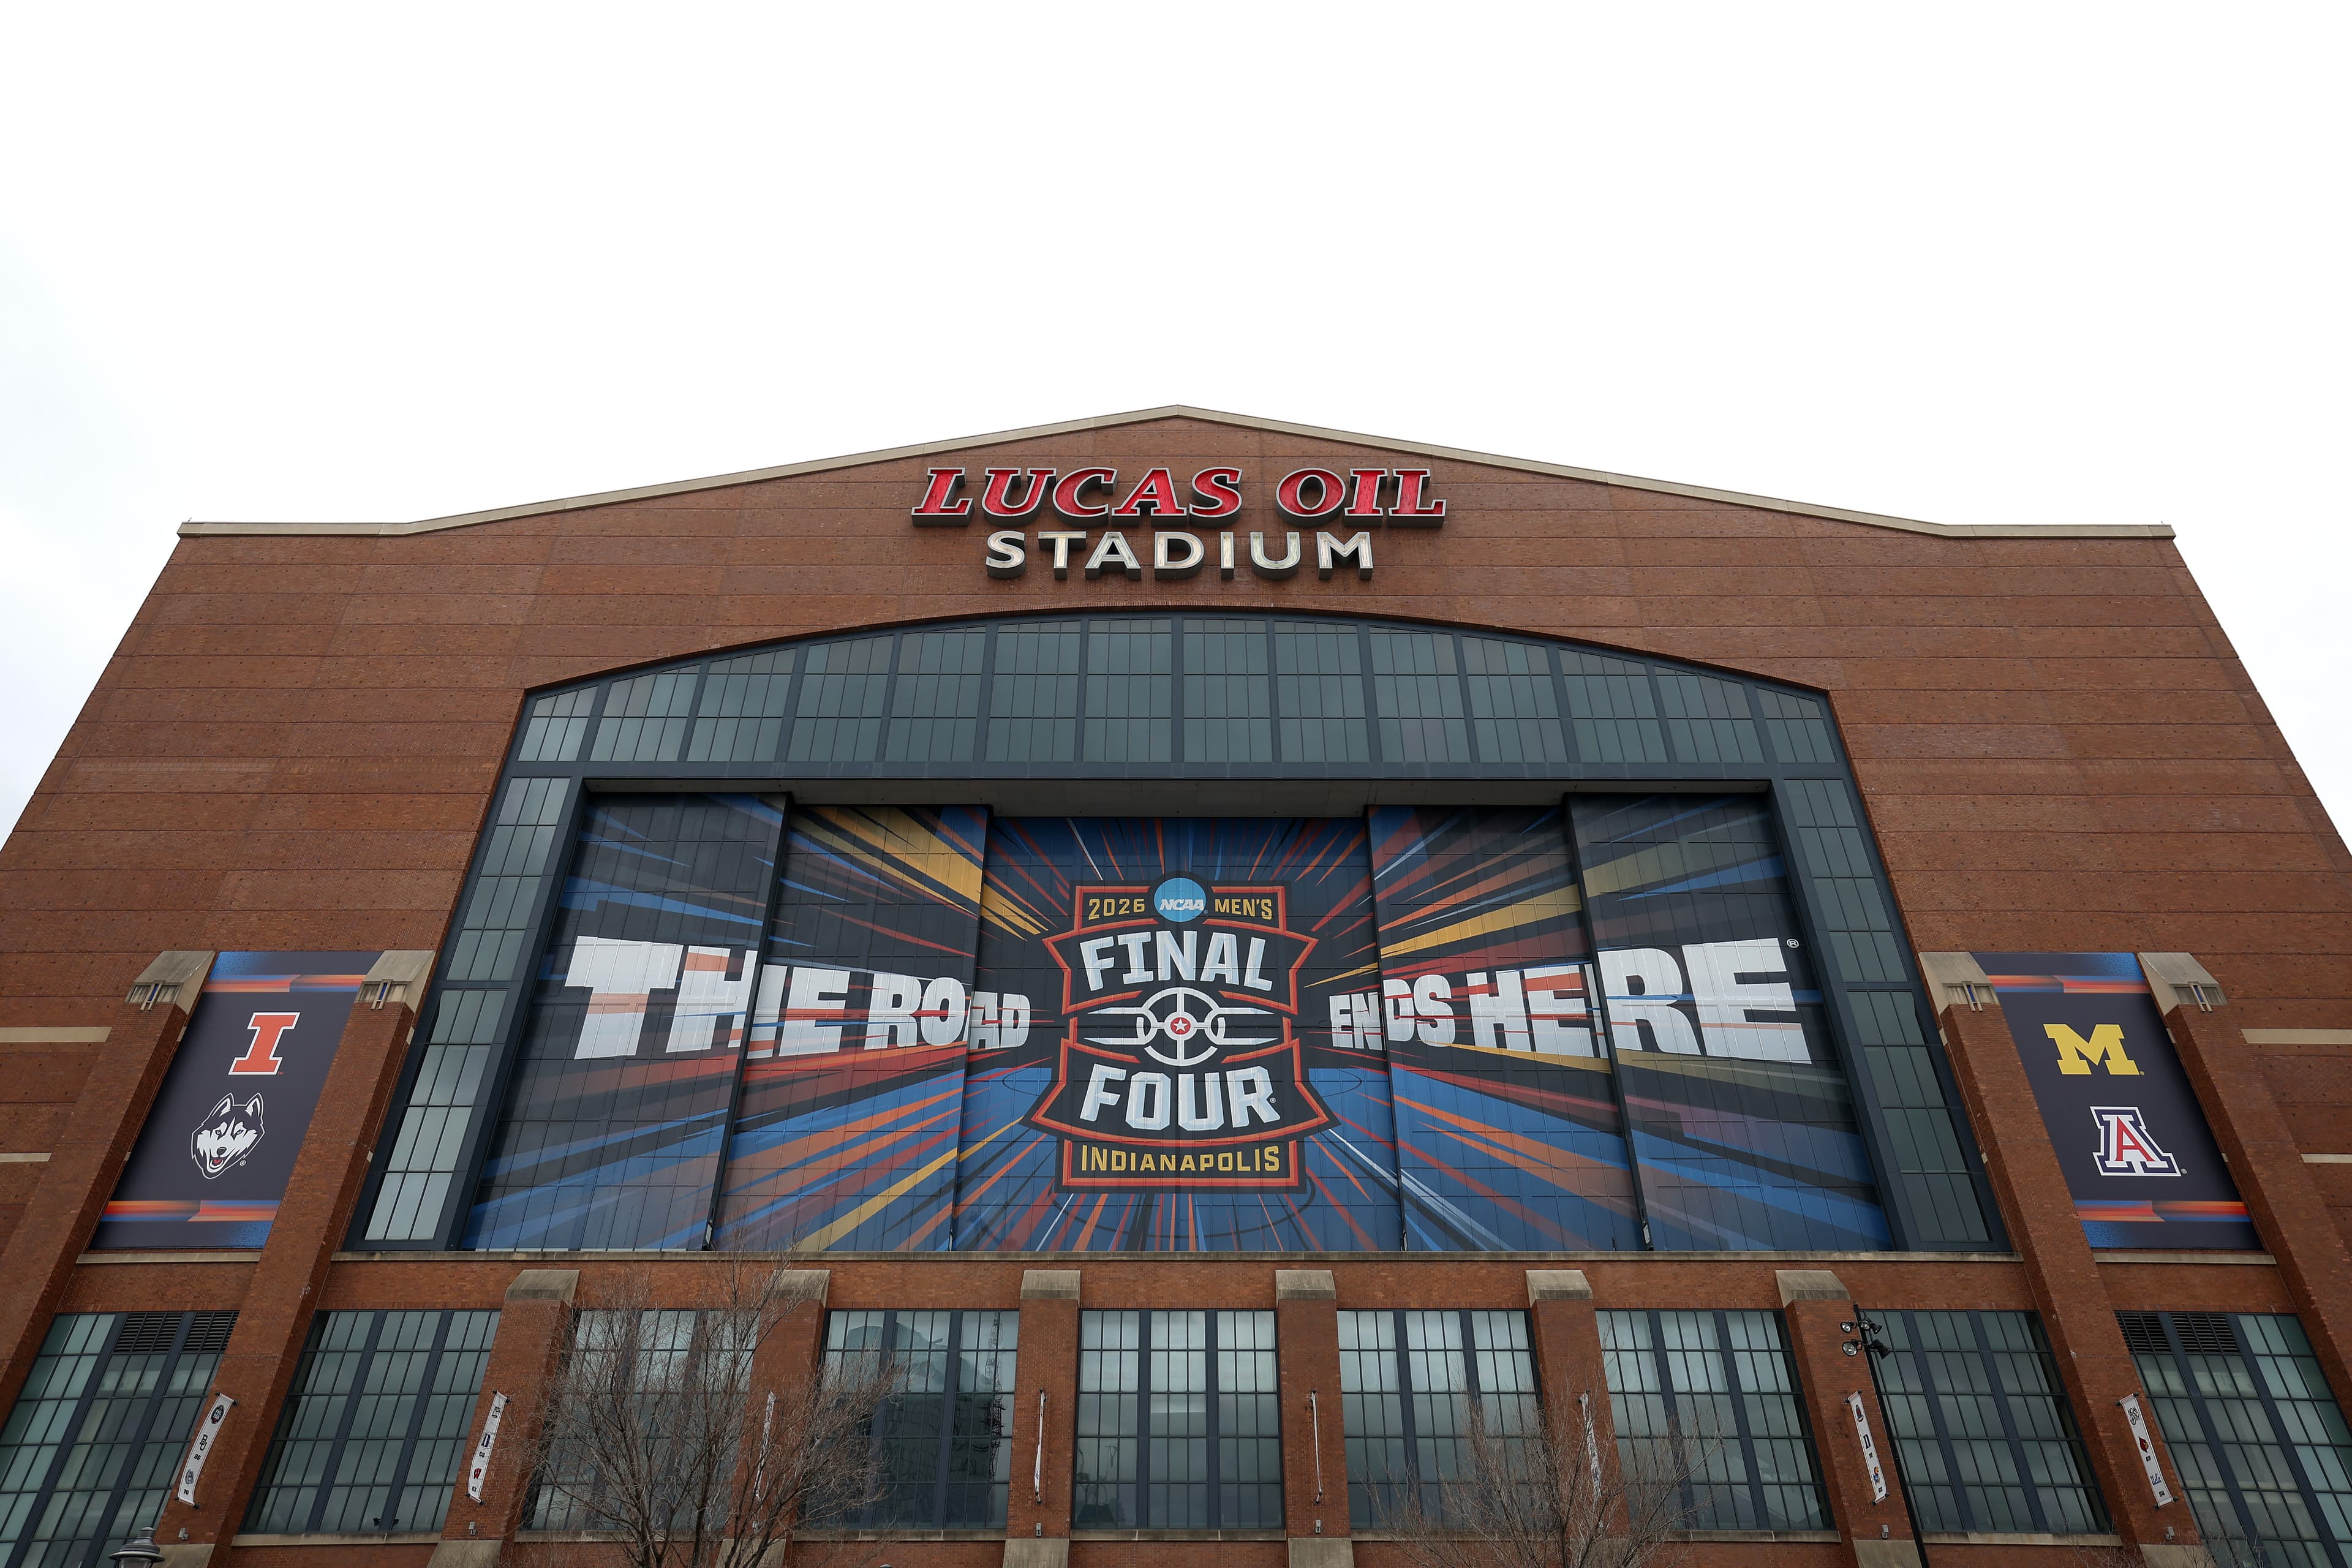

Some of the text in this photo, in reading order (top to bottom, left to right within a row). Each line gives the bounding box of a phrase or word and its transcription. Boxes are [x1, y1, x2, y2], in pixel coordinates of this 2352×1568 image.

[911, 467, 1447, 526] LUCAS OIL
[986, 530, 1373, 579] STADIUM
[1088, 899, 1145, 919] 2026
[1159, 898, 1204, 911] NCAA
[1215, 899, 1272, 919] MEN'S
[1080, 930, 1272, 991] FINAL
[564, 935, 1812, 1065] THE ROAD ENDS HERE
[228, 1012, 301, 1075] I
[2043, 1023, 2140, 1075] M
[1080, 1063, 1280, 1131] FOUR
[1082, 1145, 1280, 1171] INDIANAPOLIS
[2090, 1106, 2182, 1177] A
